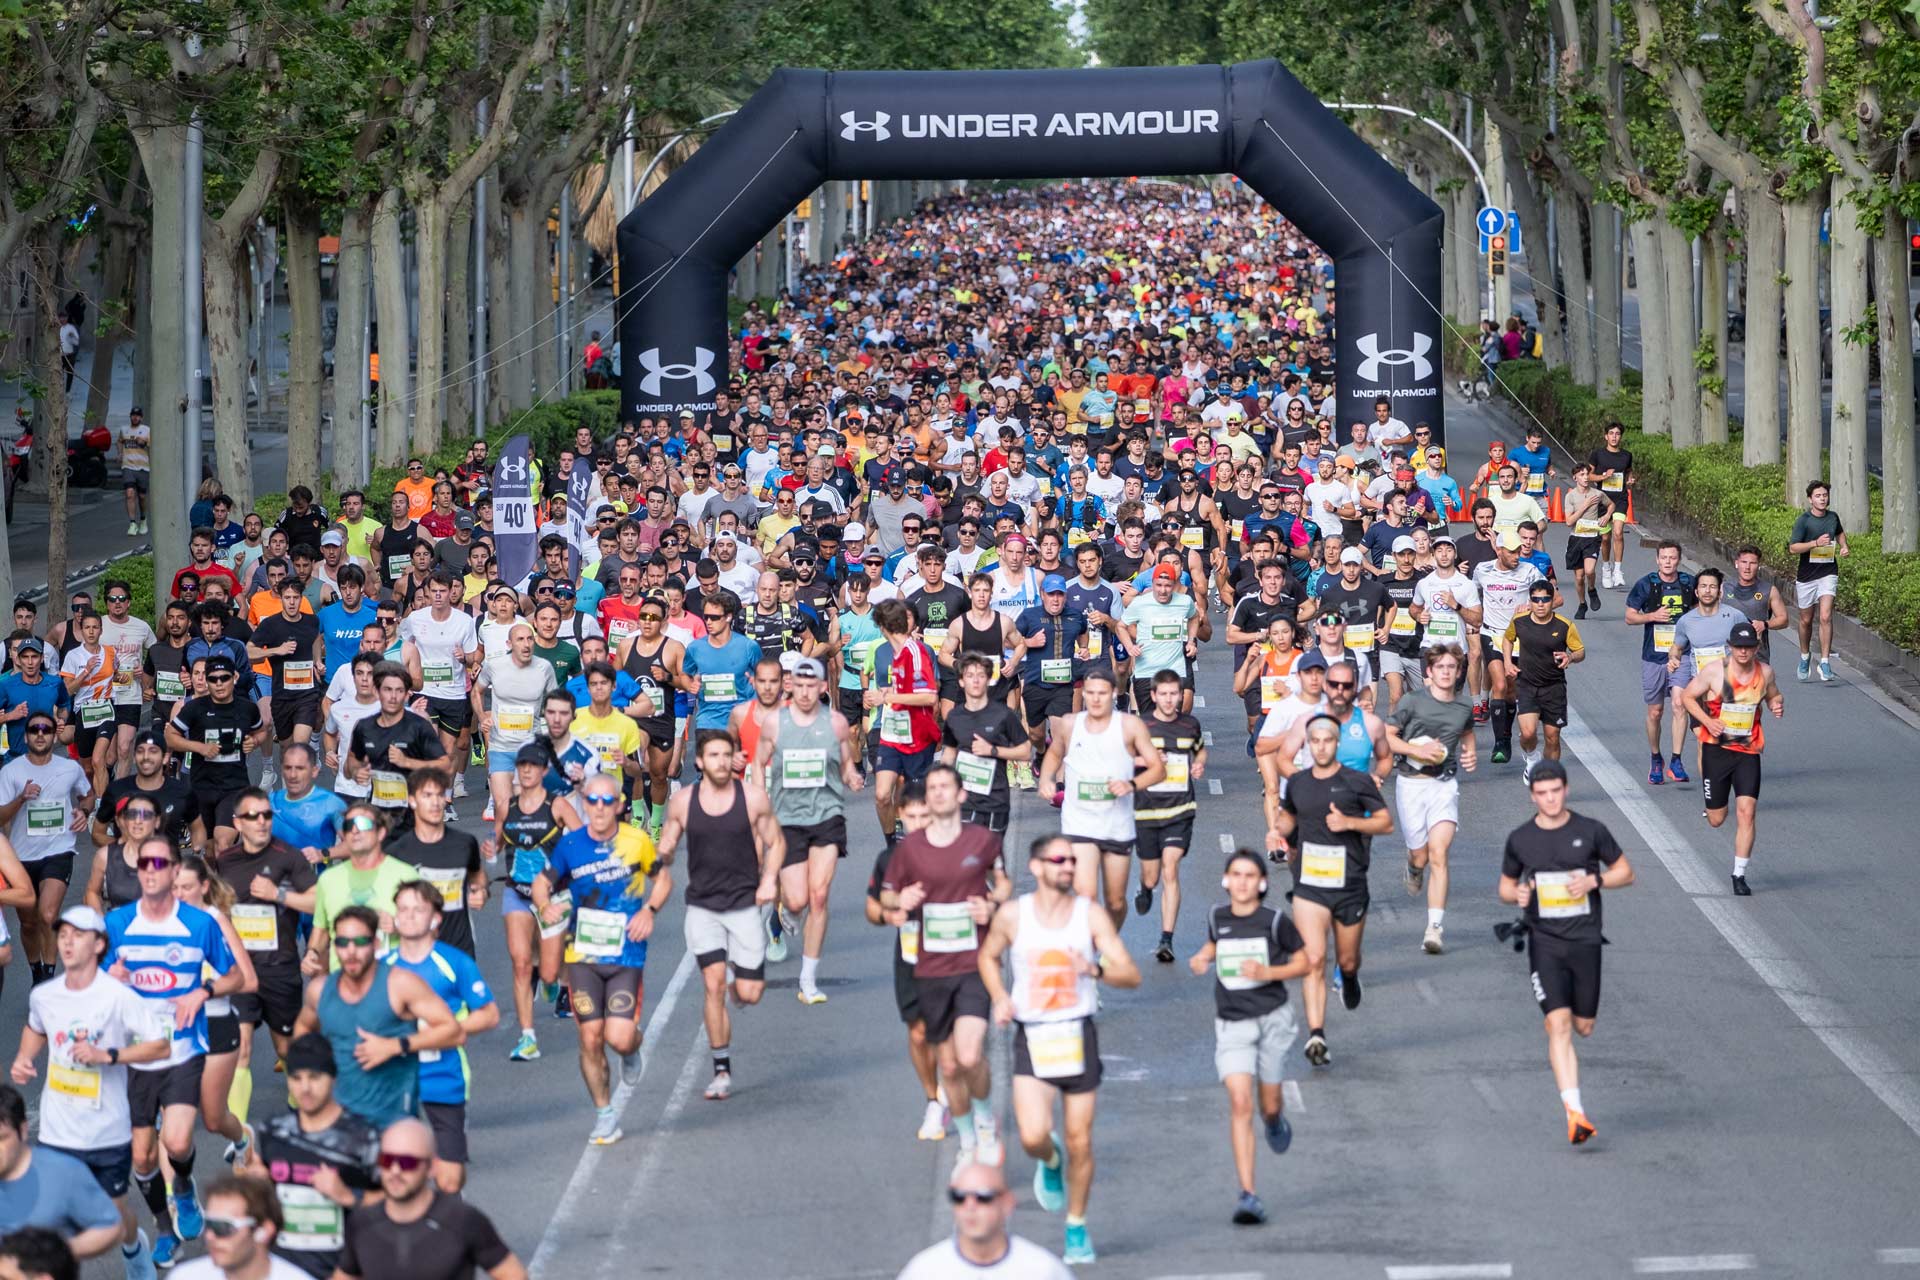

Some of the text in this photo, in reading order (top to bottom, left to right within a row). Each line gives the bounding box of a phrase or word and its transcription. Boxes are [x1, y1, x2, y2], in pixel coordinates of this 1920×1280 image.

[900, 109, 1220, 138] UNDER ARMOUR
[1352, 388, 1437, 398] UNDER ARMOUR
[635, 403, 673, 412] UNDER
[931, 605, 943, 616] 6K
[334, 629, 363, 639] WILD
[1703, 778, 1713, 800] UVU
[135, 973, 167, 986] DANI
